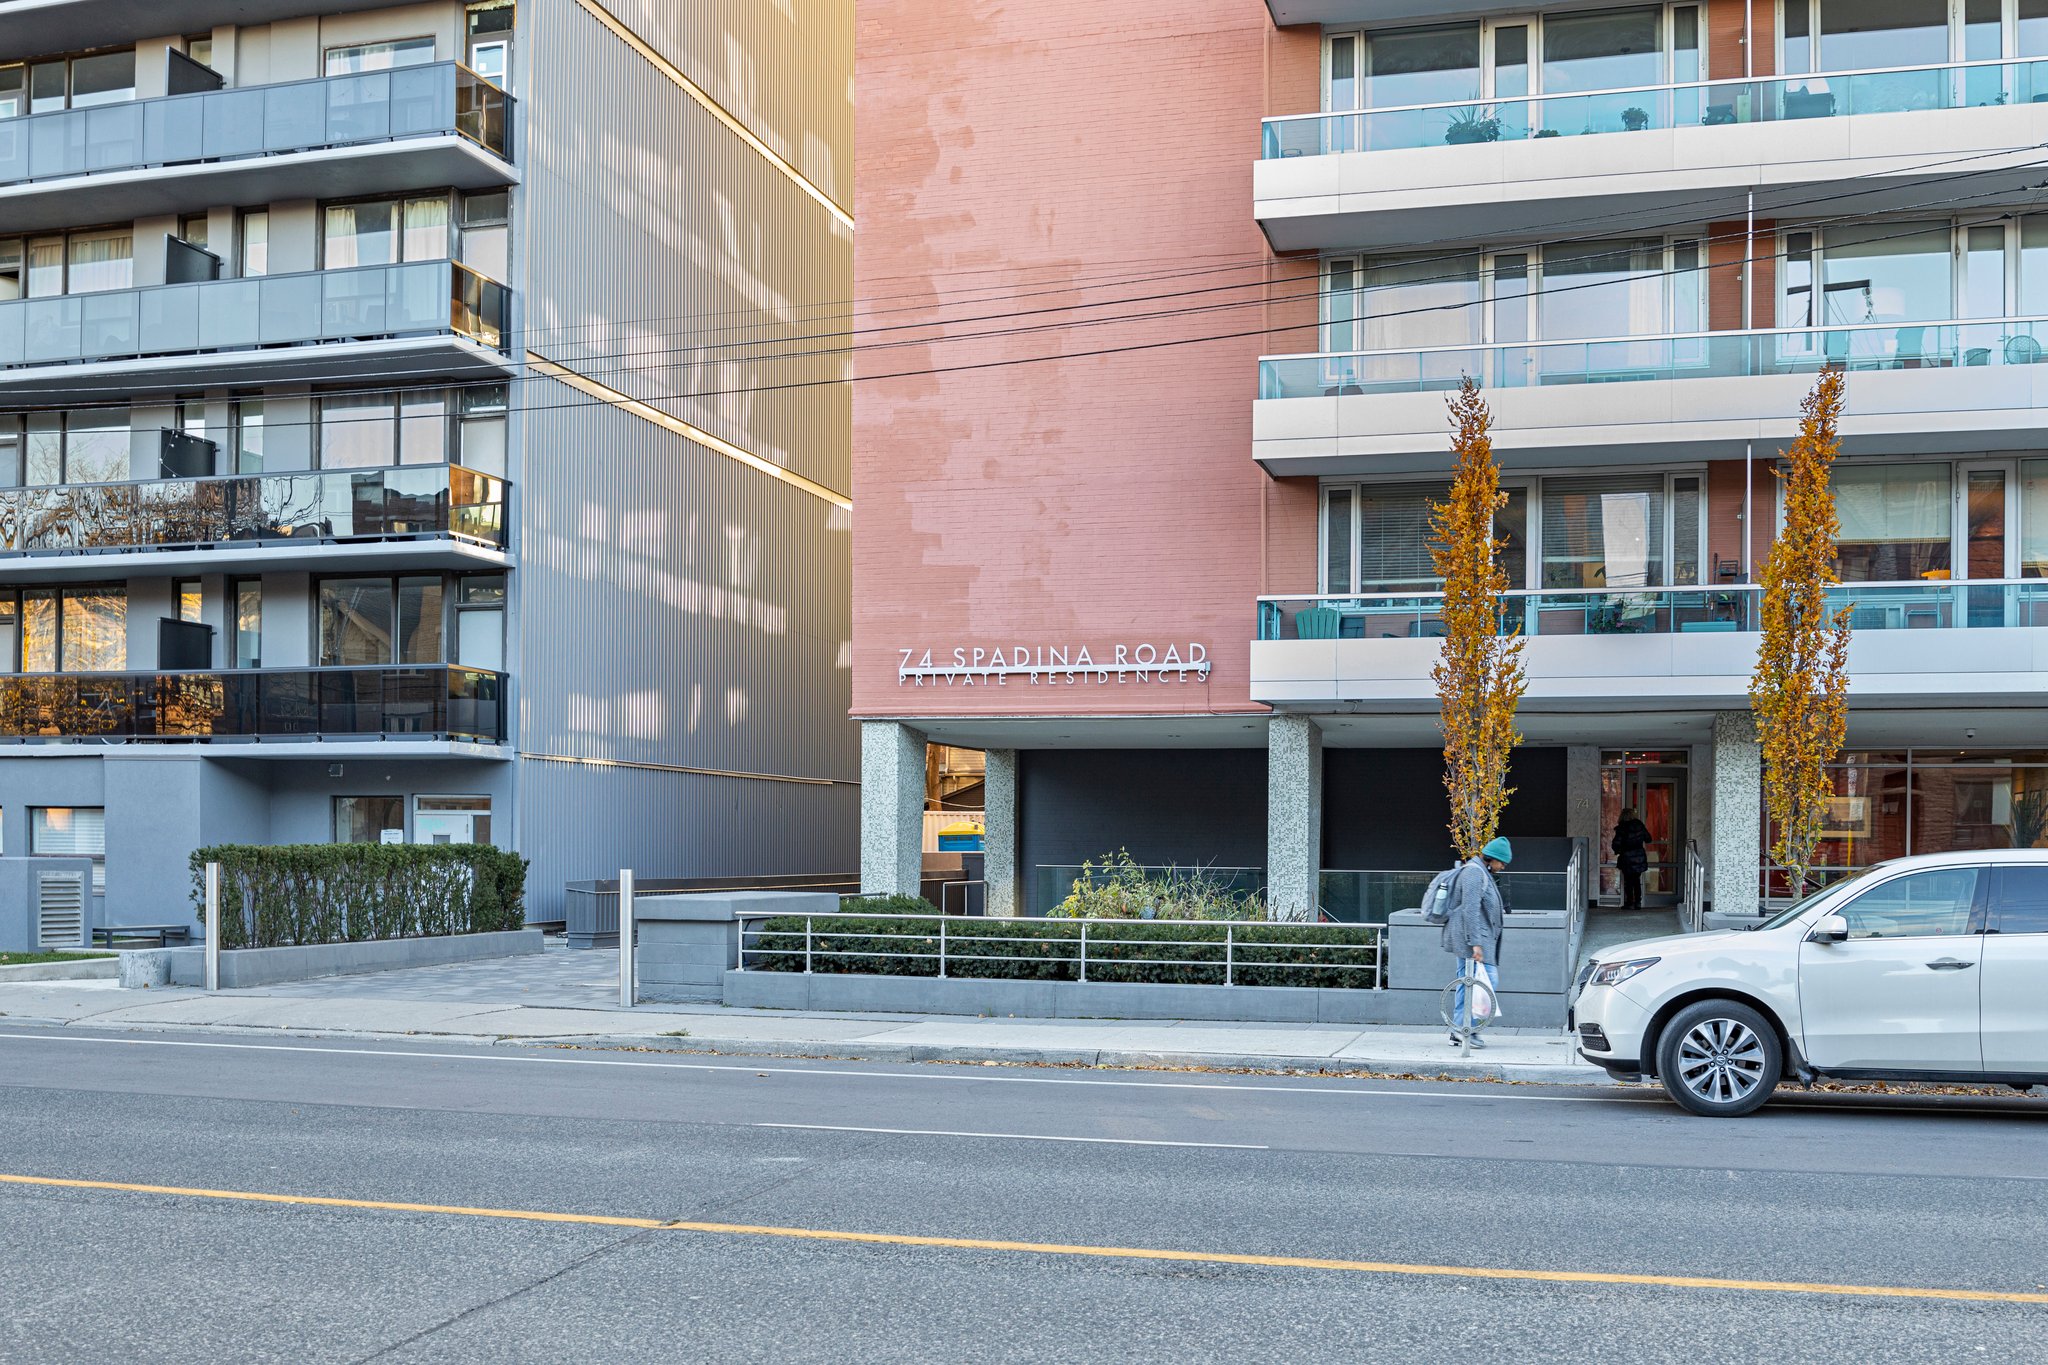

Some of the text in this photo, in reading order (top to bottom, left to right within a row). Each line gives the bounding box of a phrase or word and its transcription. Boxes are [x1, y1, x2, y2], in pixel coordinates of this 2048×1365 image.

[898, 642, 1206, 668] 74 SPADINA ROAD
[899, 669, 1206, 686] PRIVATE RESIDENCES
[1576, 798, 1590, 809] 74
